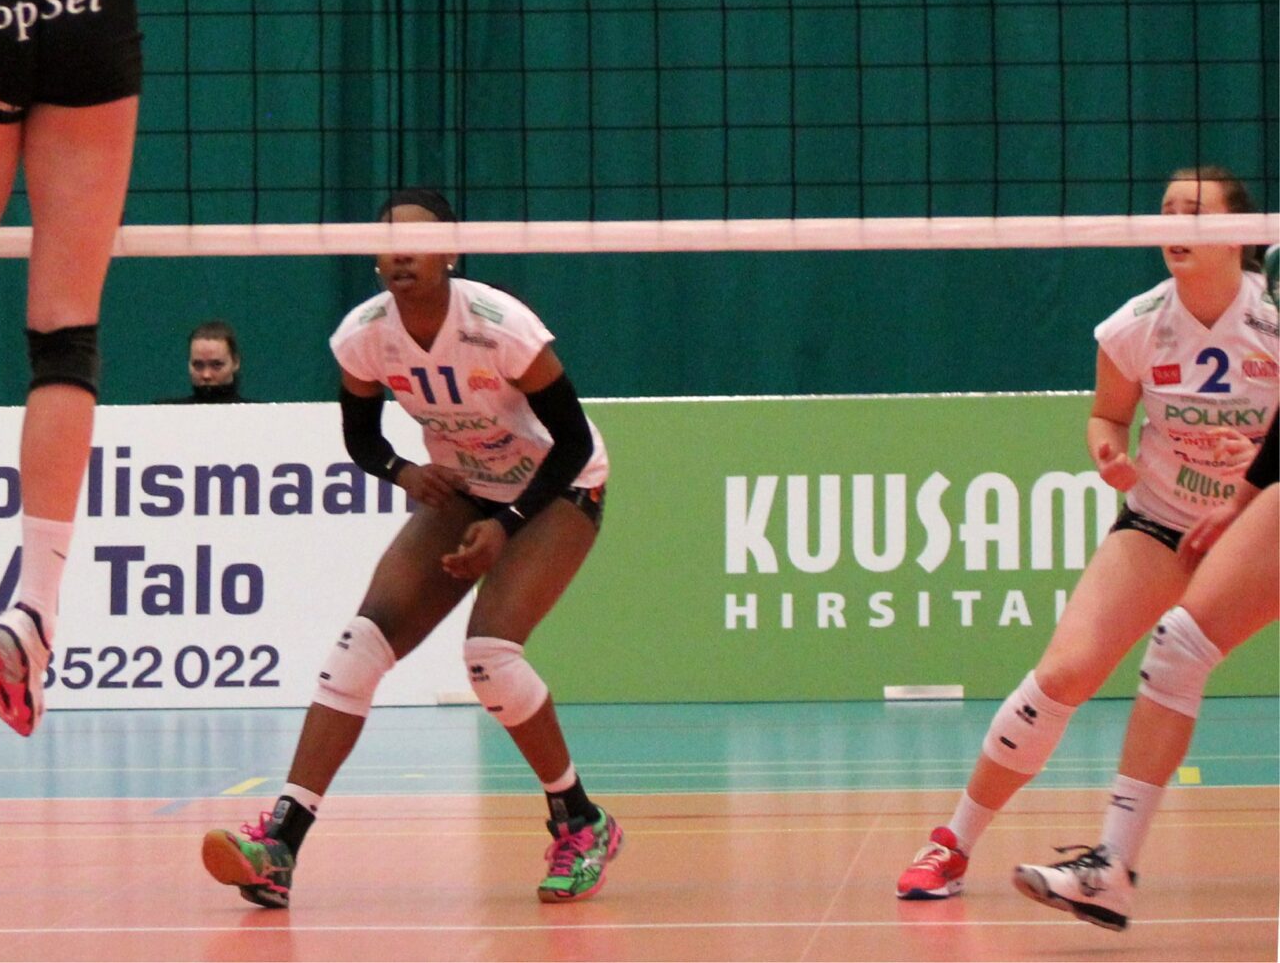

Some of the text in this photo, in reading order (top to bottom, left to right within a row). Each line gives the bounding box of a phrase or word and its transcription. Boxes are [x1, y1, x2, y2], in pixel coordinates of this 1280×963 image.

[410, 365, 463, 405] 11
[1195, 346, 1232, 394] 2
[725, 470, 1118, 574] KUUSAM
[94, 544, 265, 617] Talo
[174, 644, 280, 690] 022
